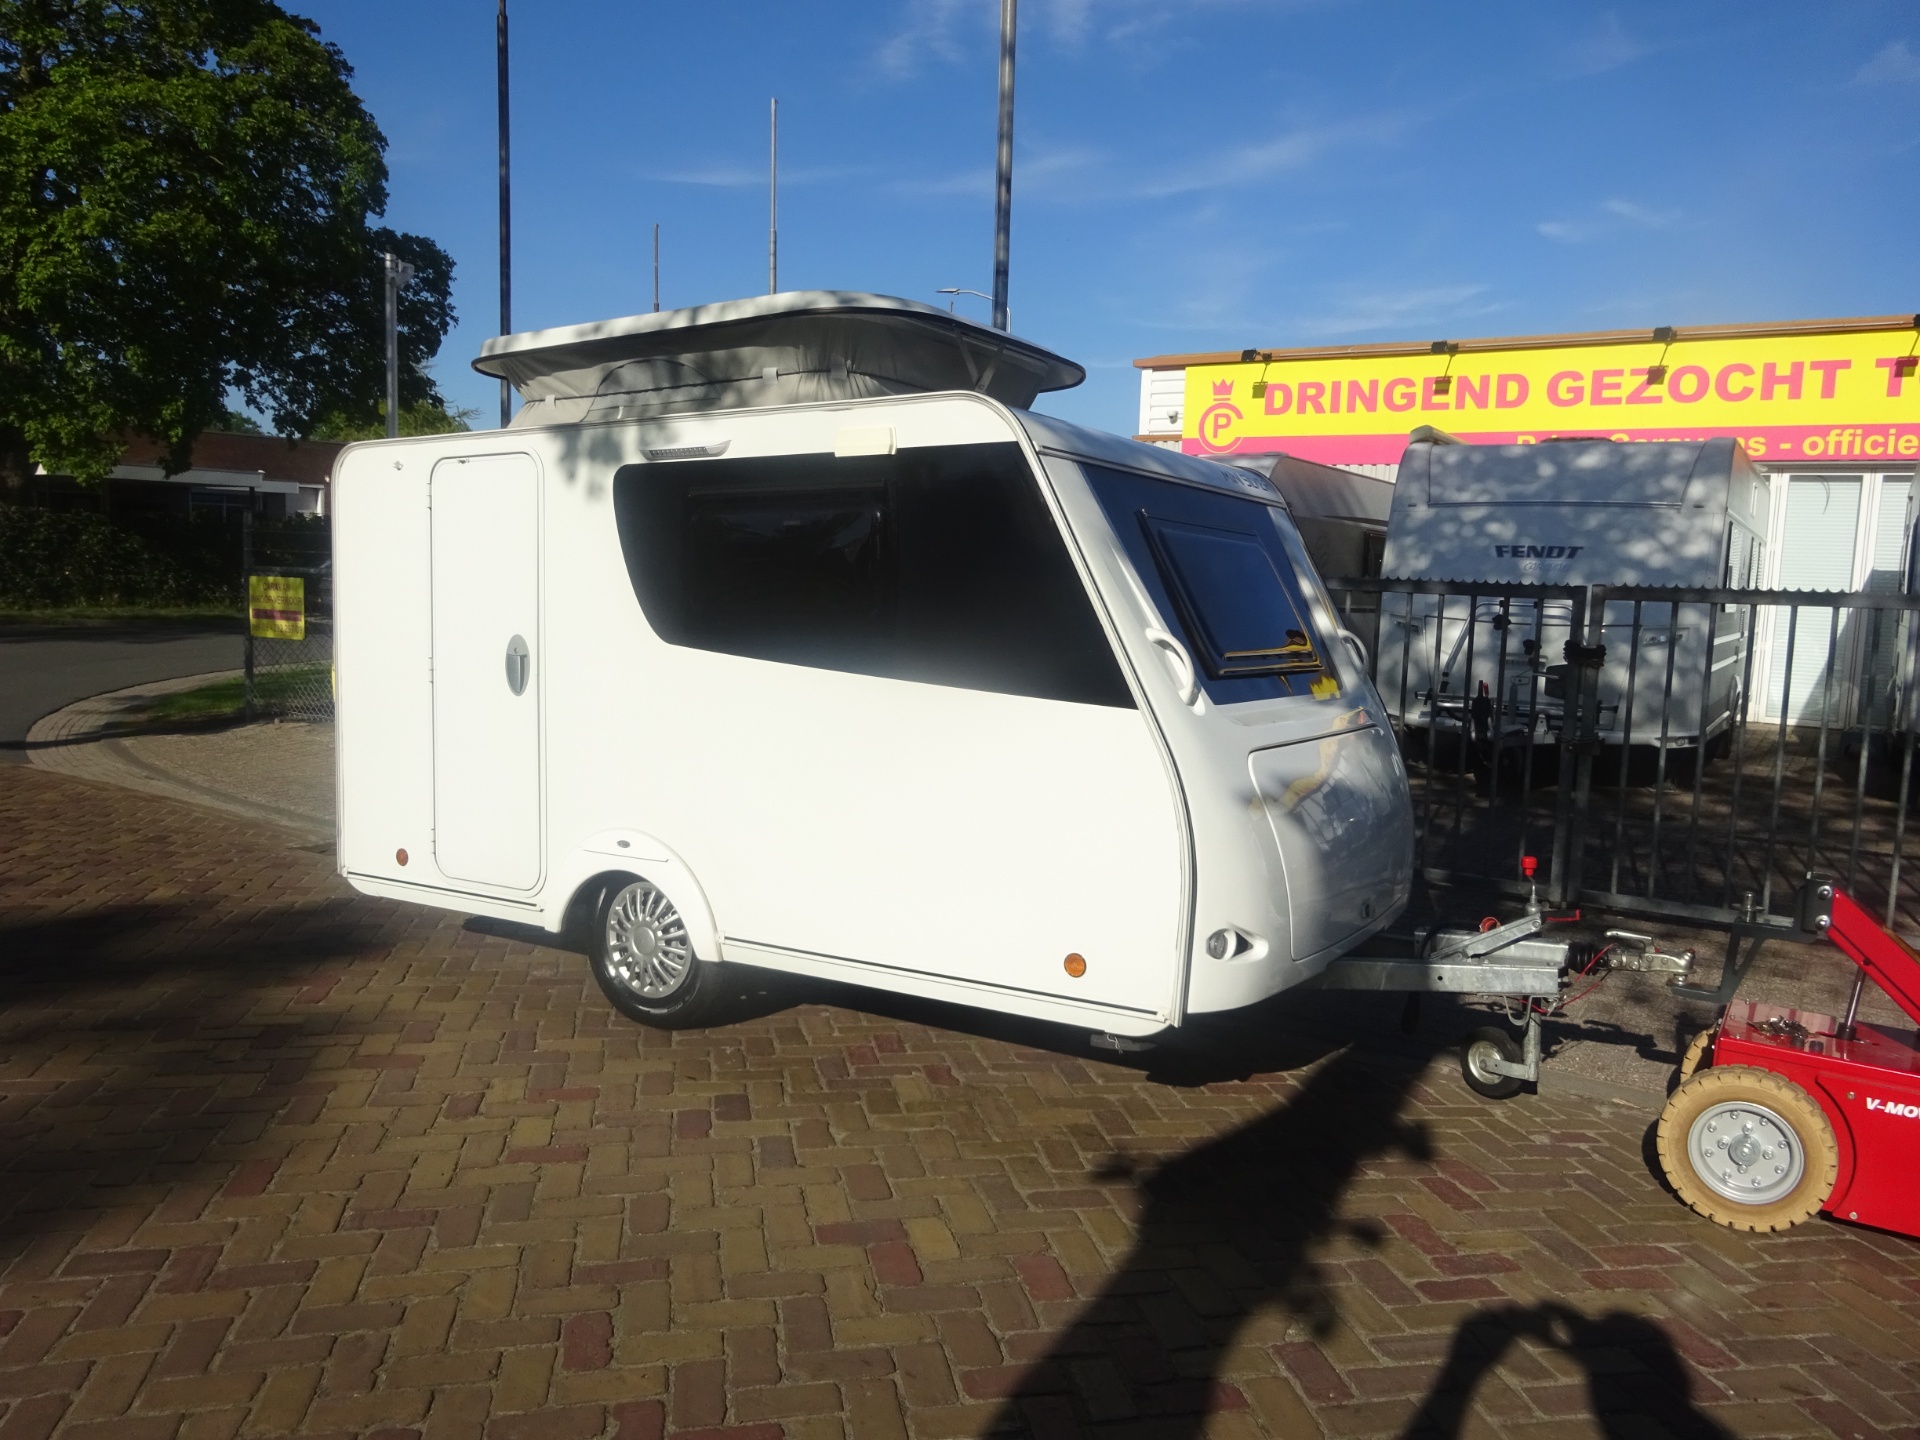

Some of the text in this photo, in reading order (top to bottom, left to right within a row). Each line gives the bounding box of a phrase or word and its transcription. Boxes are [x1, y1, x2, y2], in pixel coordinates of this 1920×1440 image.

[1264, 357, 1920, 415] DRINGEND GEZOCHT T
[1802, 429, 1920, 456] officie
[1495, 545, 1585, 559] FENDT
[1866, 1097, 1920, 1119] V-MO
